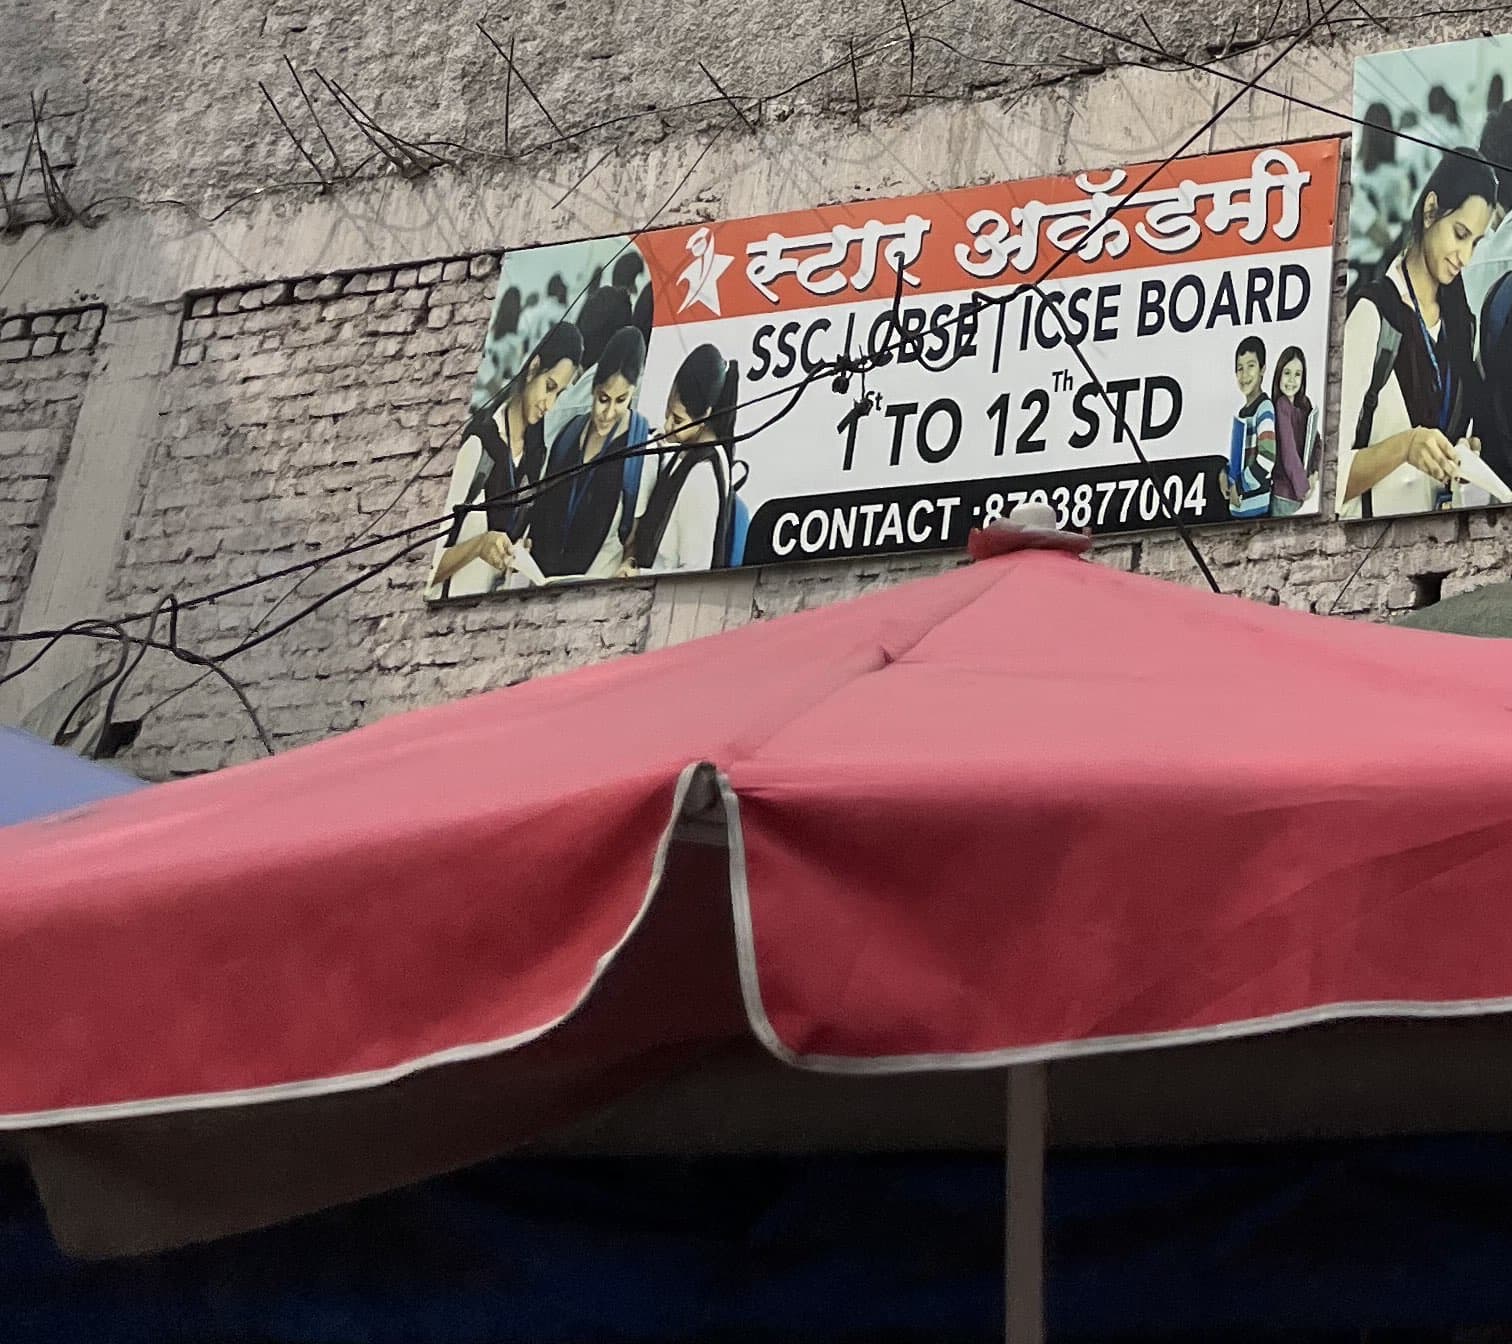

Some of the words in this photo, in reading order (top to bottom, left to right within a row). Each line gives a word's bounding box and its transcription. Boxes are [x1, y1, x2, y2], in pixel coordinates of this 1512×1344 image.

[745, 214, 932, 304] स्टार
[954, 148, 1312, 280] अकॅडमी
[746, 318, 833, 382] SSC
[868, 304, 979, 365] CBSE
[1018, 279, 1123, 351] ICSE
[1136, 264, 1312, 338] BOARD
[884, 397, 963, 467] TO
[1068, 375, 1184, 450] STD
[771, 497, 961, 555] CONTACT
